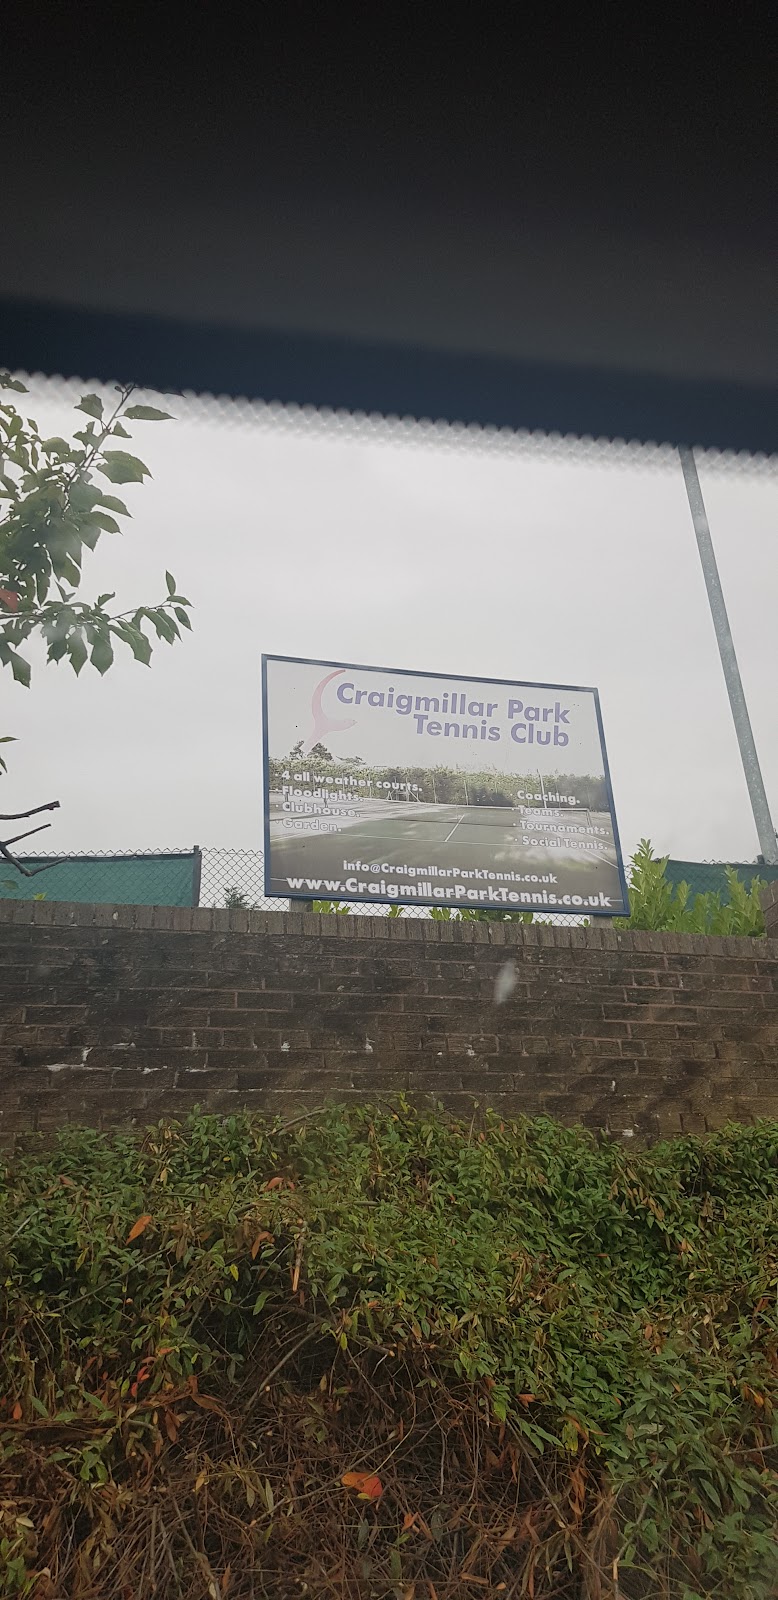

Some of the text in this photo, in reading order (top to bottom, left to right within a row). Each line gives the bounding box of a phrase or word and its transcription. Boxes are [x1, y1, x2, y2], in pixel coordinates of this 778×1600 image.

[336, 682, 571, 724] Craigmillar Park
[413, 714, 570, 747] Tennis Club
[281, 770, 423, 792] 4 all weather courts.
[282, 786, 363, 803] Floodlights.
[517, 790, 581, 805] Coaching.
[282, 801, 361, 818] Clubhouse.
[518, 805, 564, 817] Teams.
[282, 818, 342, 832] Garden.
[520, 820, 610, 835] Tournaments.
[522, 836, 608, 851] Social Tennis.
[343, 860, 558, 884] info@CraigmillarParkTennis.co.uk
[286, 876, 612, 908] www.CraigmillarParkTennis.co.uk
